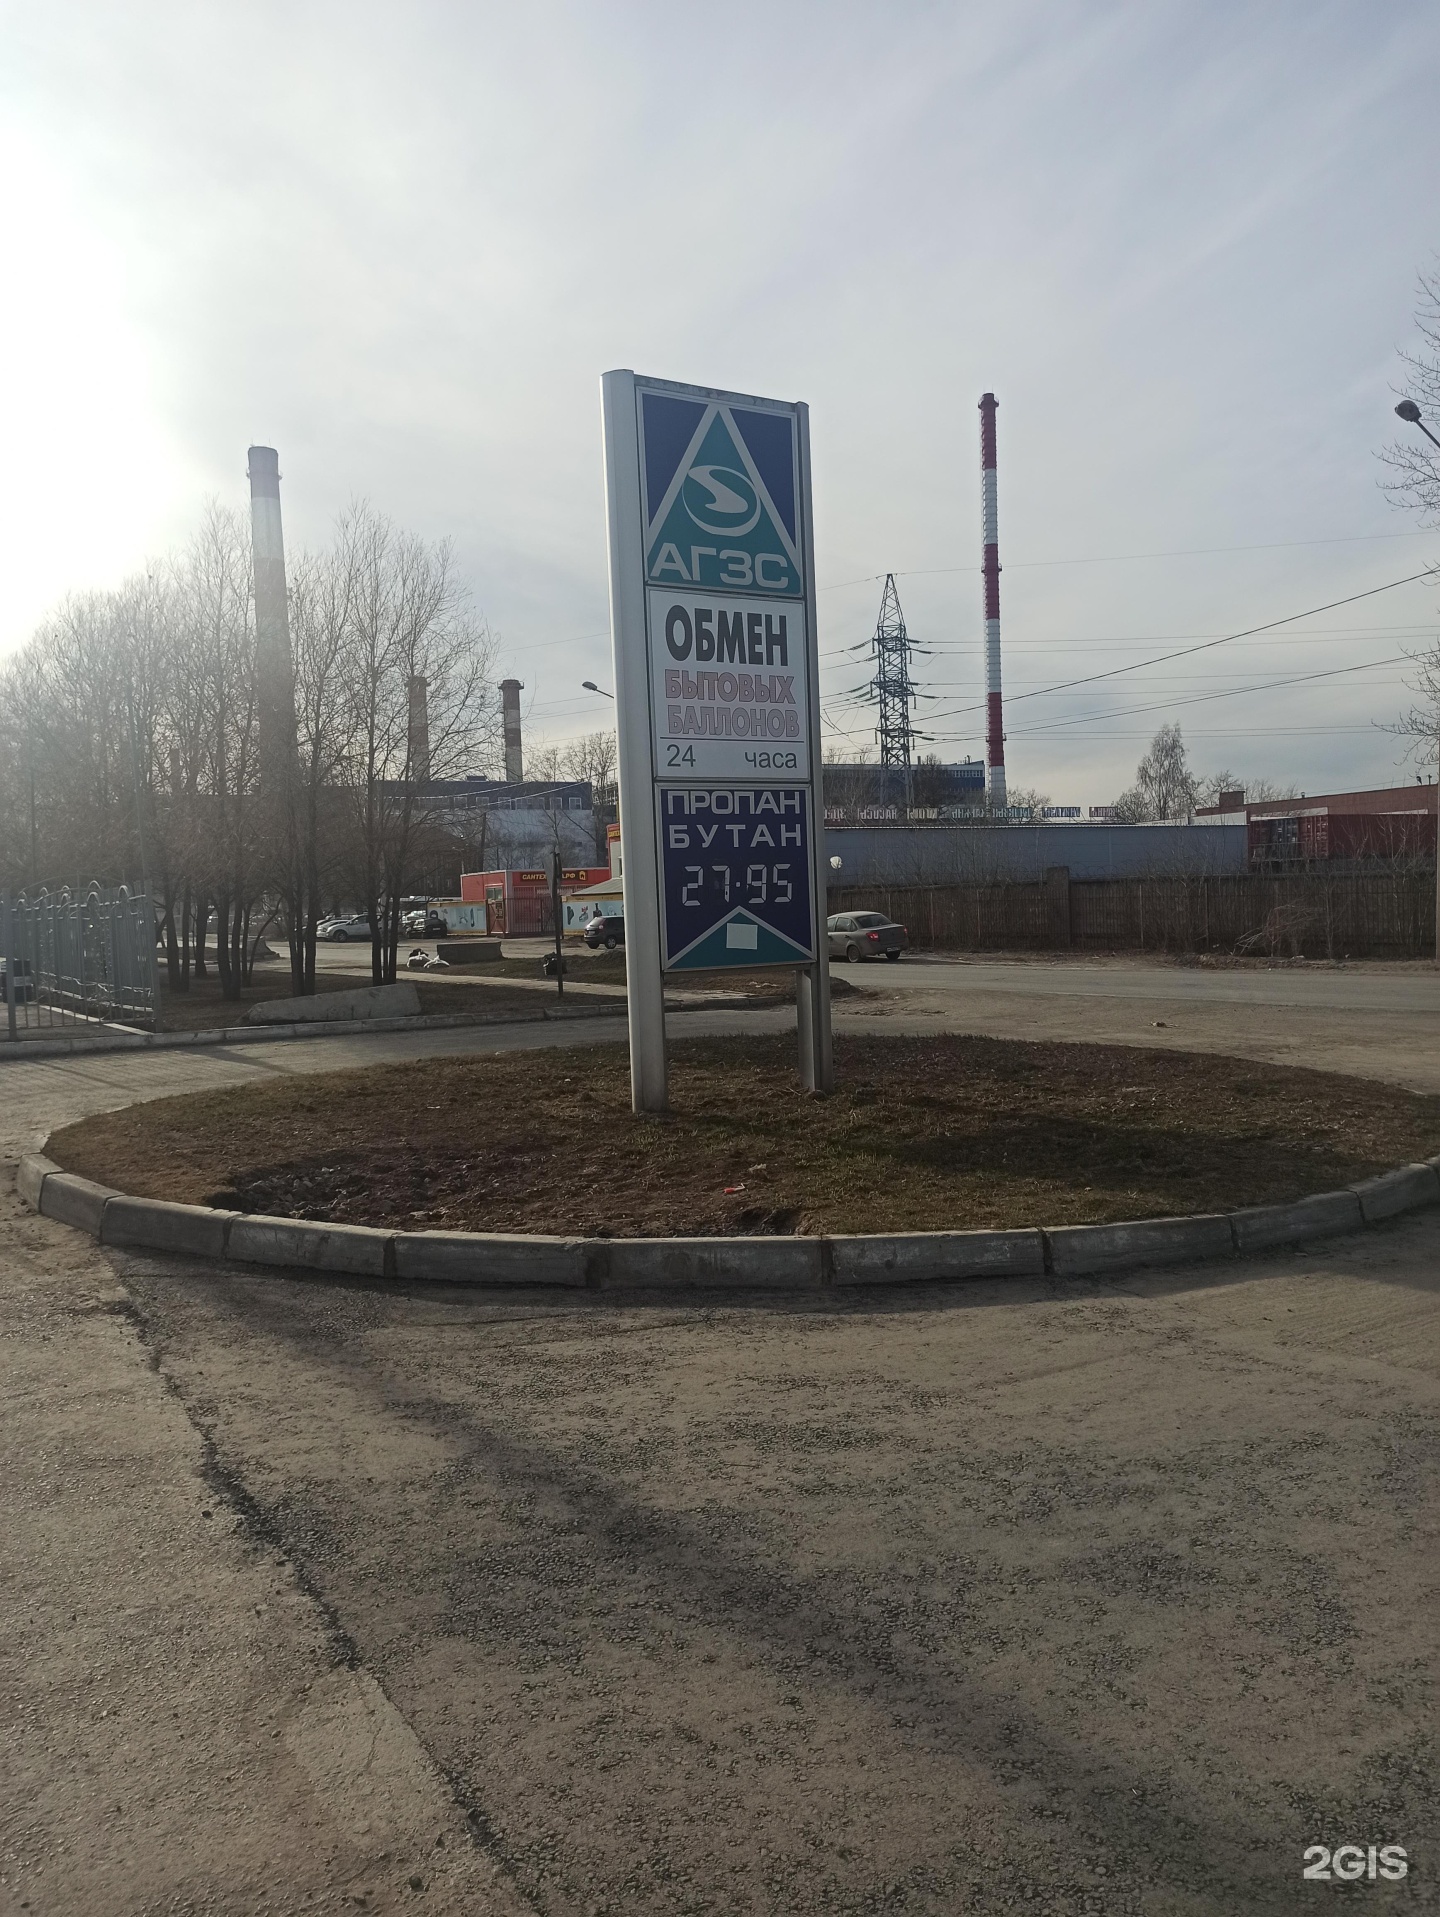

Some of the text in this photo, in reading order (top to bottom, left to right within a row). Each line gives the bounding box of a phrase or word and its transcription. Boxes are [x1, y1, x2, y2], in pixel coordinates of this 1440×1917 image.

[650, 542, 788, 588] АГЗС
[665, 605, 788, 666] ОБМЕН
[664, 669, 796, 704] БЫТОВЫХ
[668, 705, 800, 737] БАЛЛОНОВ
[666, 744, 797, 769] 24 часа
[667, 791, 800, 815] ПРОПАН
[669, 824, 802, 849] БУТАН
